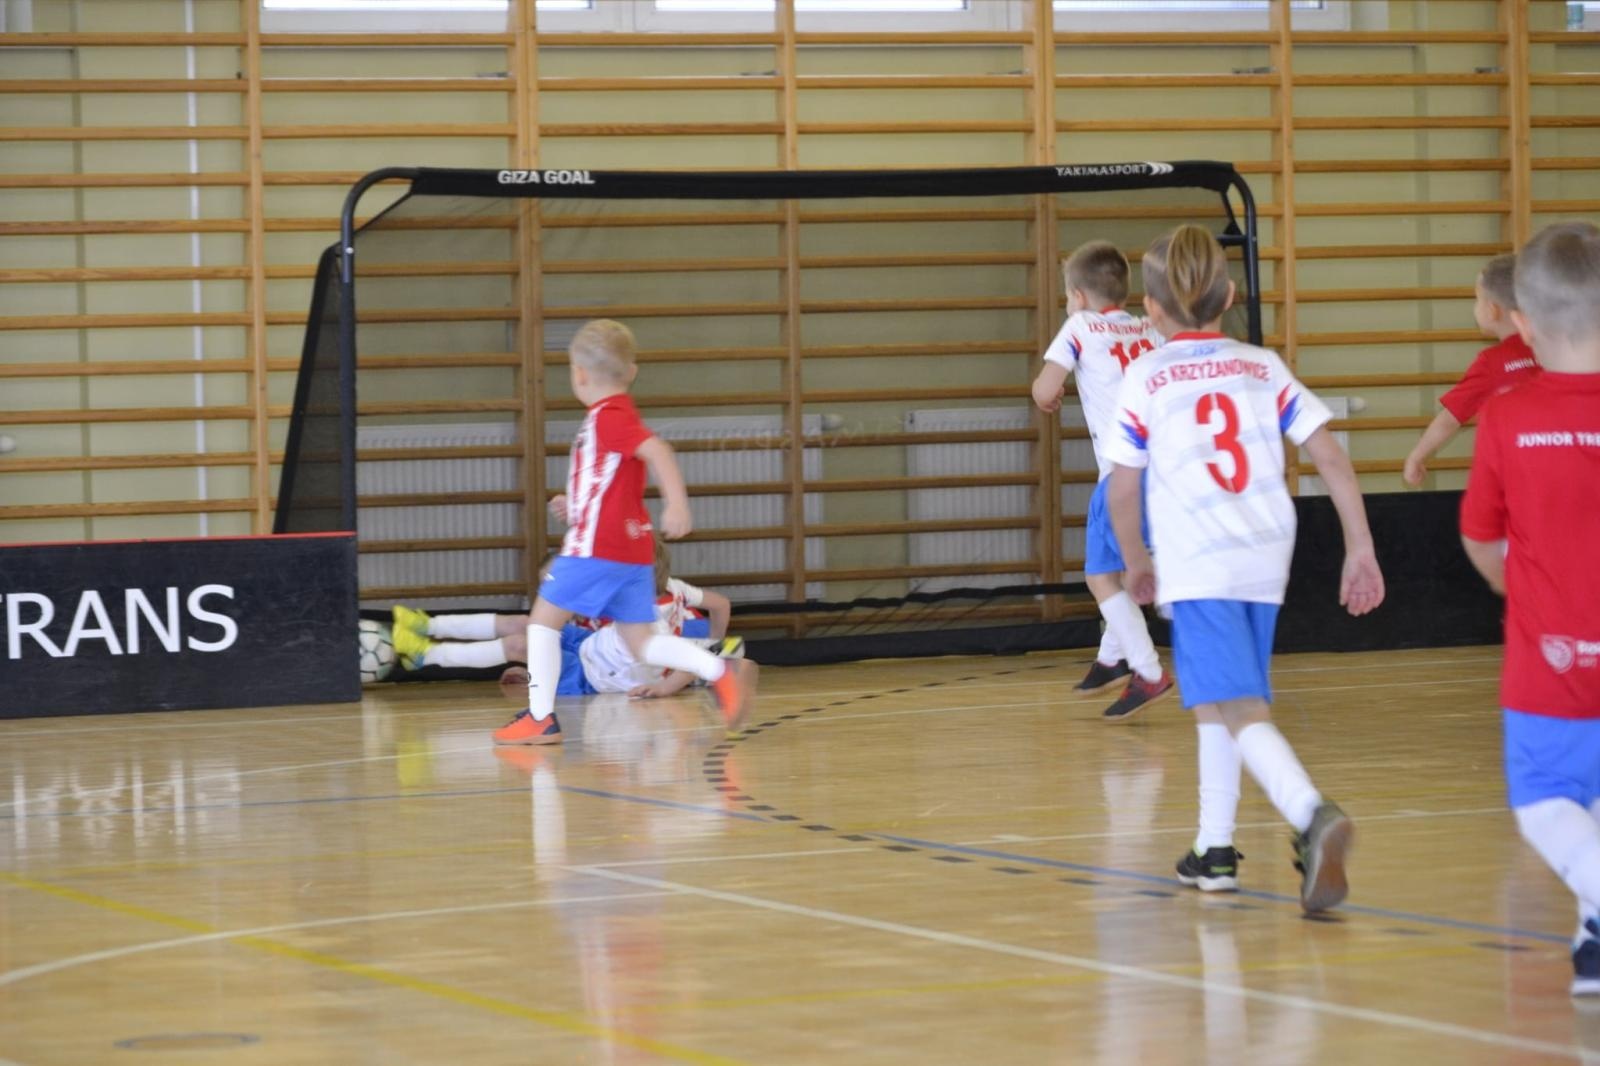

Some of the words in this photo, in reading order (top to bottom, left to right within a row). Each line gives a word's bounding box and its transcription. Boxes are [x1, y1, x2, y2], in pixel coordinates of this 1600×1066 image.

[498, 170, 540, 184] GIZA
[543, 170, 595, 184] GOAL
[1056, 164, 1147, 176] YAKIMASPORT
[1195, 392, 1249, 494] 3
[1516, 431, 1573, 448] JUNIOR
[0, 584, 239, 659] RANS
